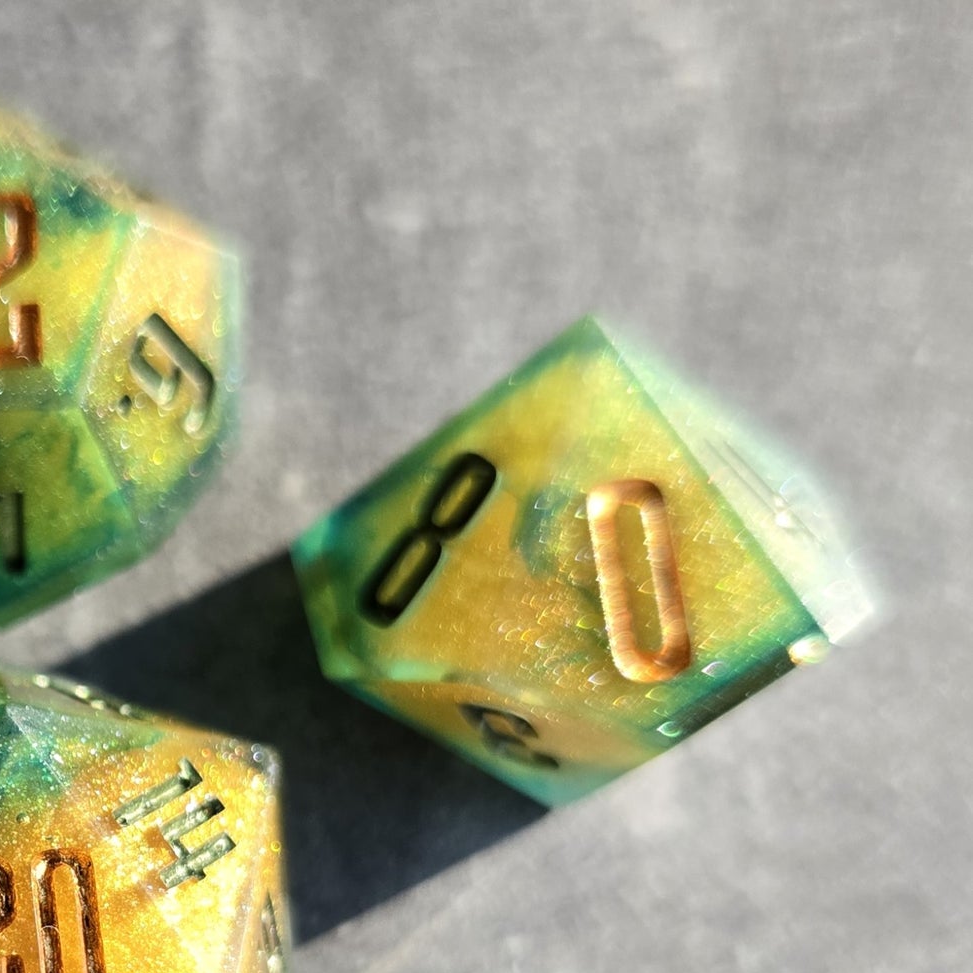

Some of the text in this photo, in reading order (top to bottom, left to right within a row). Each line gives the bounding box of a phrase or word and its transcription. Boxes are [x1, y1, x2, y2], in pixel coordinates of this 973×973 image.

[358, 452, 497, 629] 8
[586, 477, 692, 684] 0
[113, 757, 237, 890] 14
